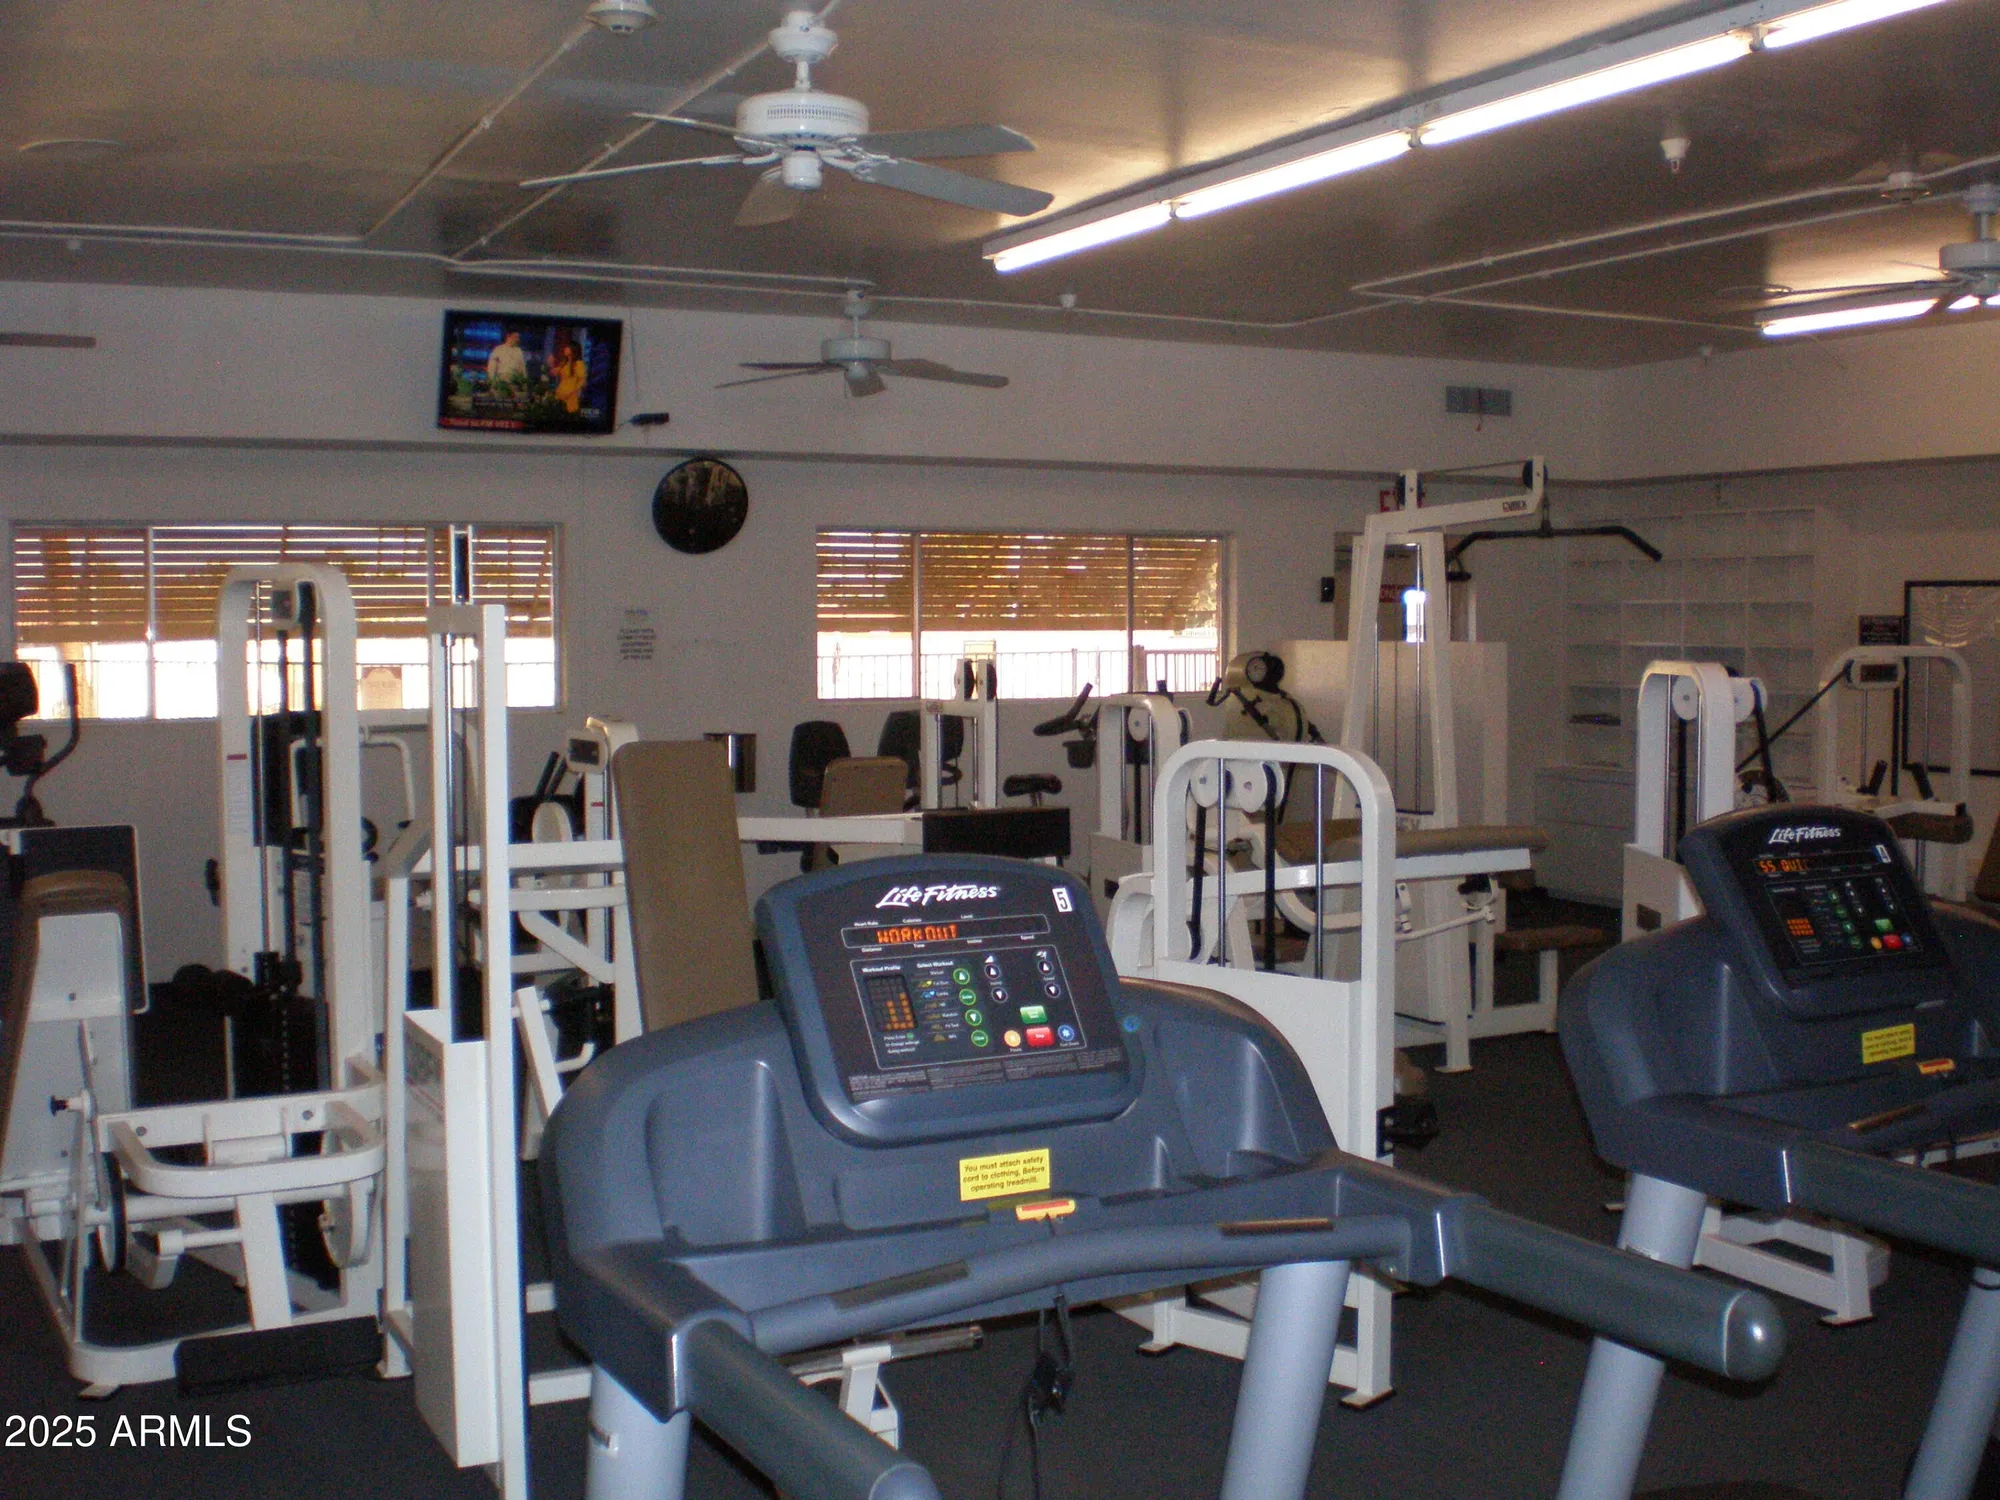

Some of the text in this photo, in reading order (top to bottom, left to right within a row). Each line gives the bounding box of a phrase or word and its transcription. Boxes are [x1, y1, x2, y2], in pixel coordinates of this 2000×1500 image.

[1768, 827, 1841, 844] Life Fitness
[875, 884, 998, 908] Life Fitness
[877, 924, 957, 944] WORKOUT
[964, 1156, 1044, 1173] You must attach safety
[963, 1175, 980, 1183] cord
[981, 1173, 989, 1181] to
[1022, 1166, 1045, 1175] Before
[970, 1182, 1005, 1192] operating
